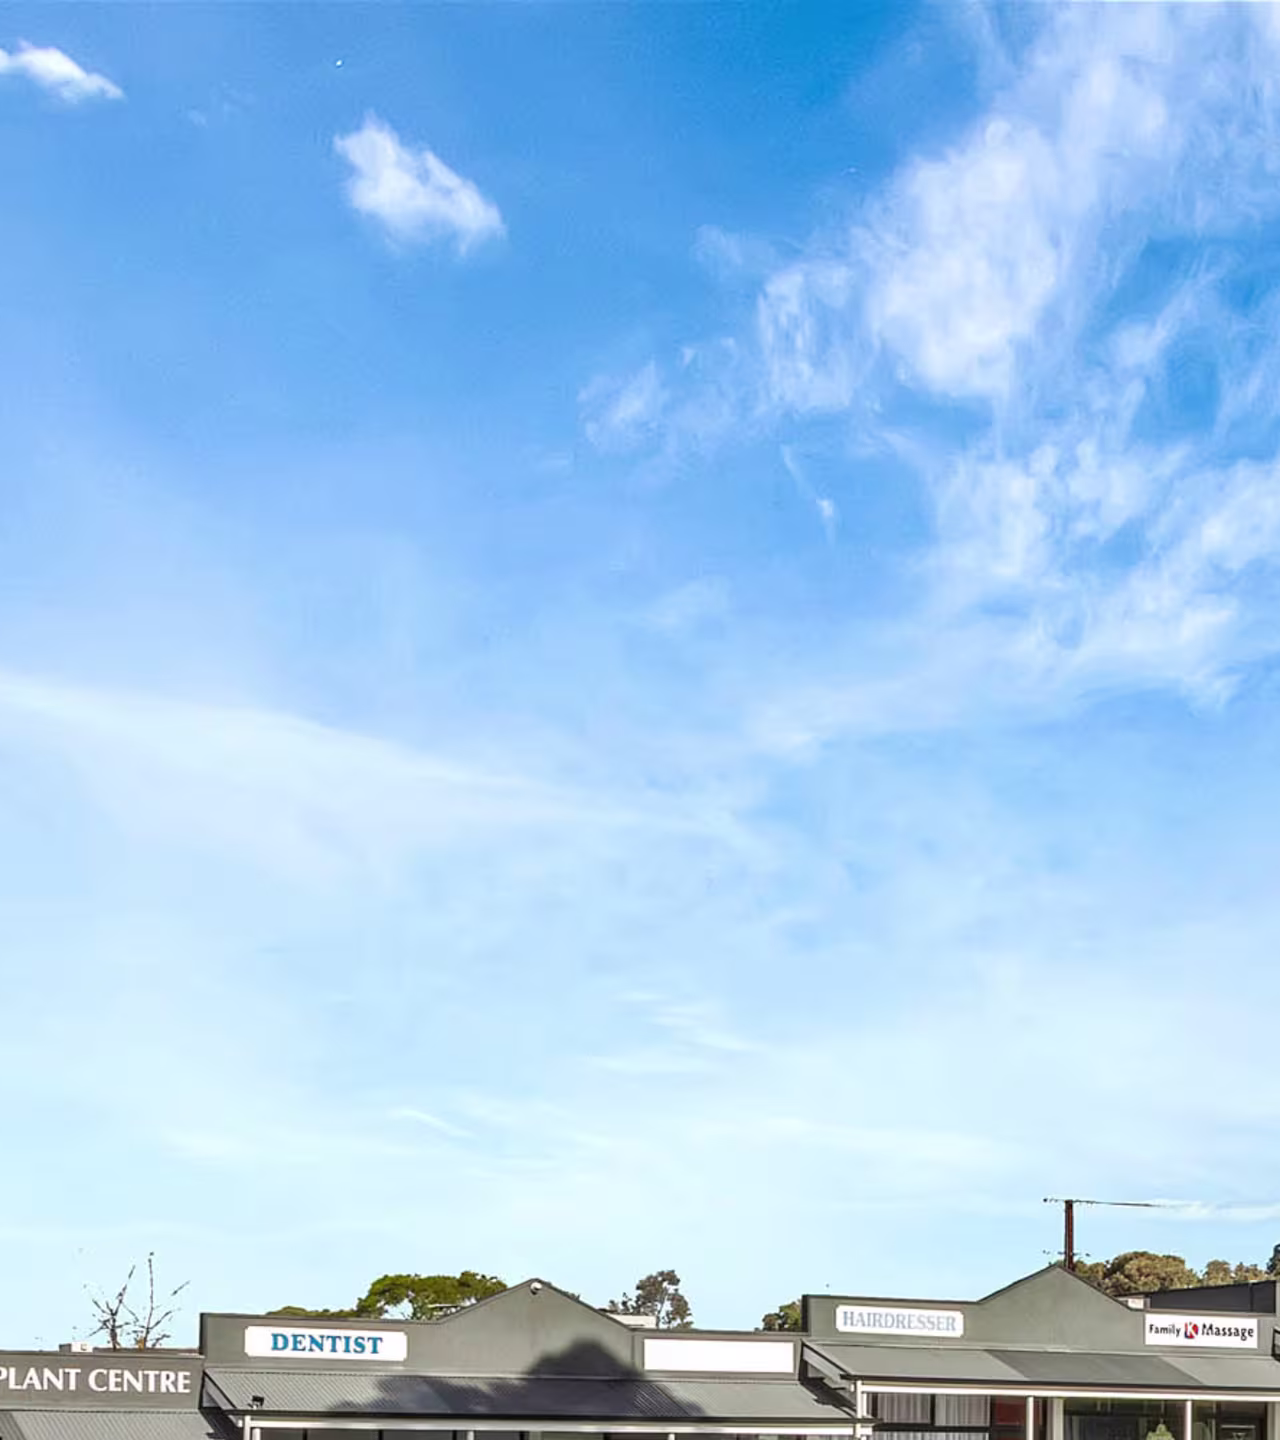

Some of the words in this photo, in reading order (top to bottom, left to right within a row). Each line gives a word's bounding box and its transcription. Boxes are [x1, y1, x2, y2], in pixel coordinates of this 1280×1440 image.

[843, 1311, 956, 1331] HAIRDRESSER
[1149, 1324, 1181, 1337] Family
[1201, 1323, 1254, 1341] Massage
[271, 1333, 383, 1354] DENTIST
[88, 1368, 191, 1393] CENTRE
